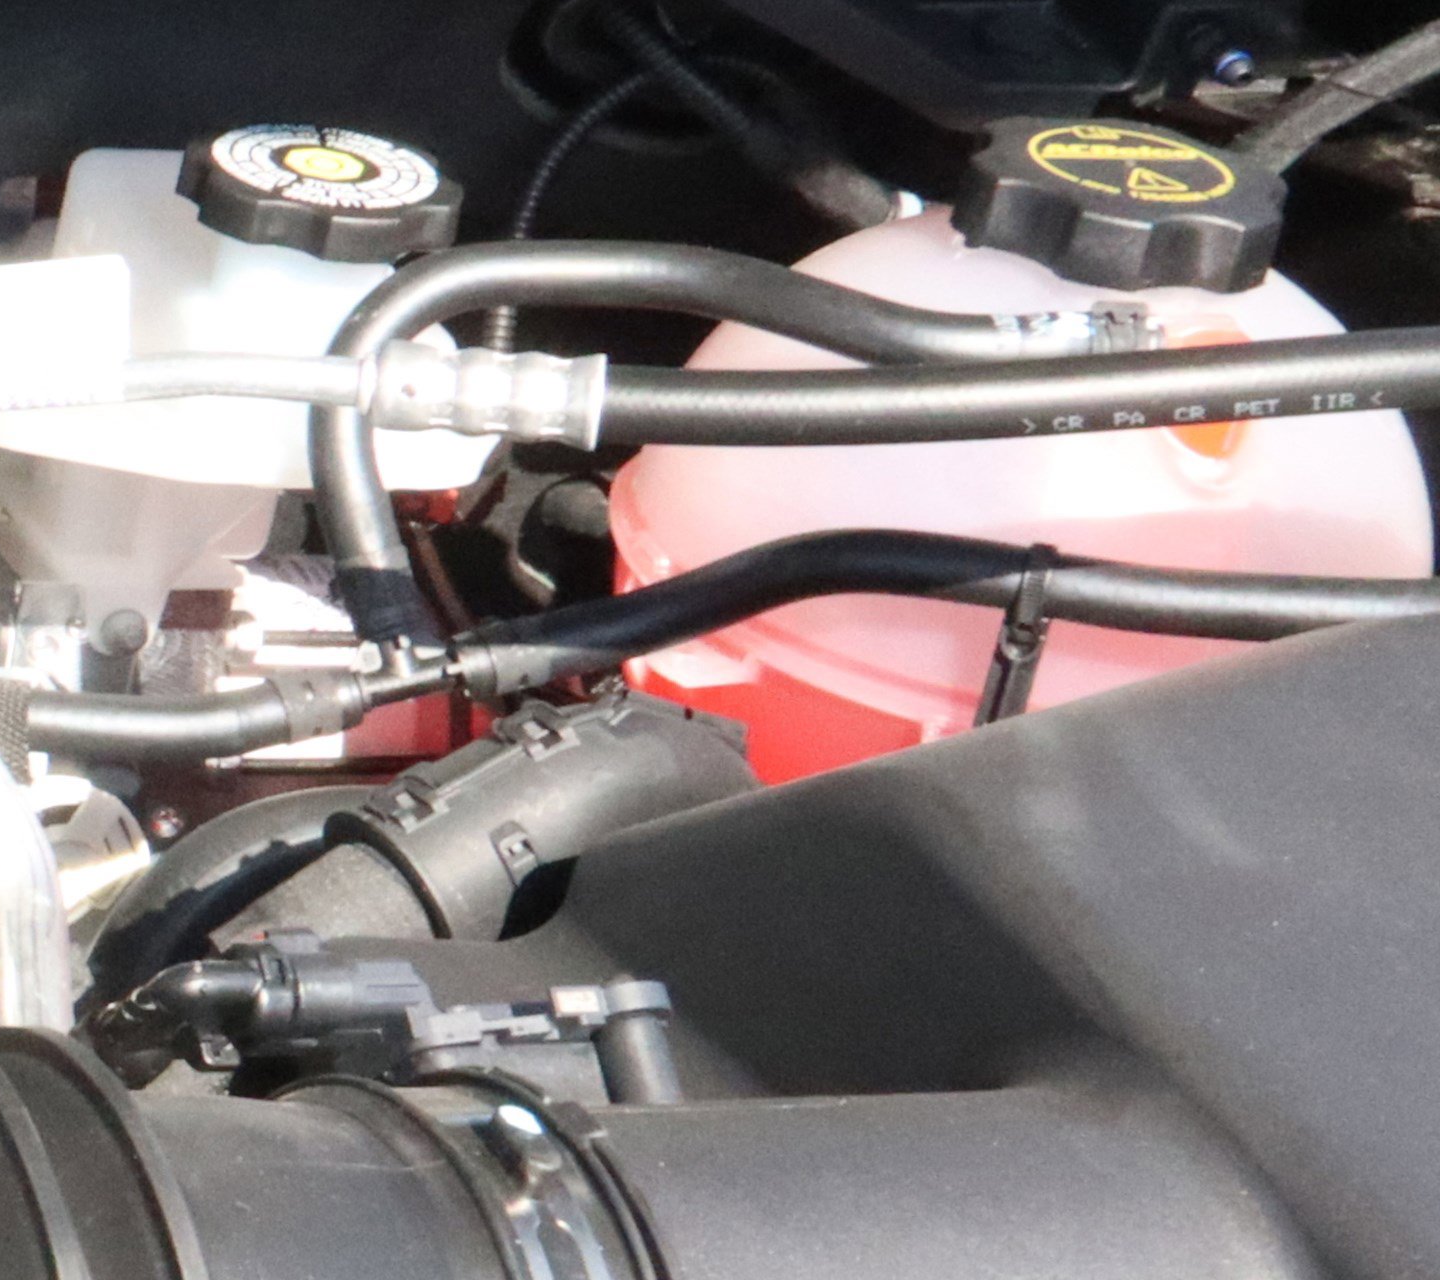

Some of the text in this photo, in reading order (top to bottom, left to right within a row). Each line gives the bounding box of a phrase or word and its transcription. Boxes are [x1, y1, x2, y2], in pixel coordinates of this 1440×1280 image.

[1053, 416, 1084, 431] CR
[1113, 411, 1145, 426] PA
[1174, 405, 1206, 421] CR
[1234, 398, 1280, 417] PET
[1311, 392, 1356, 410] IIR
